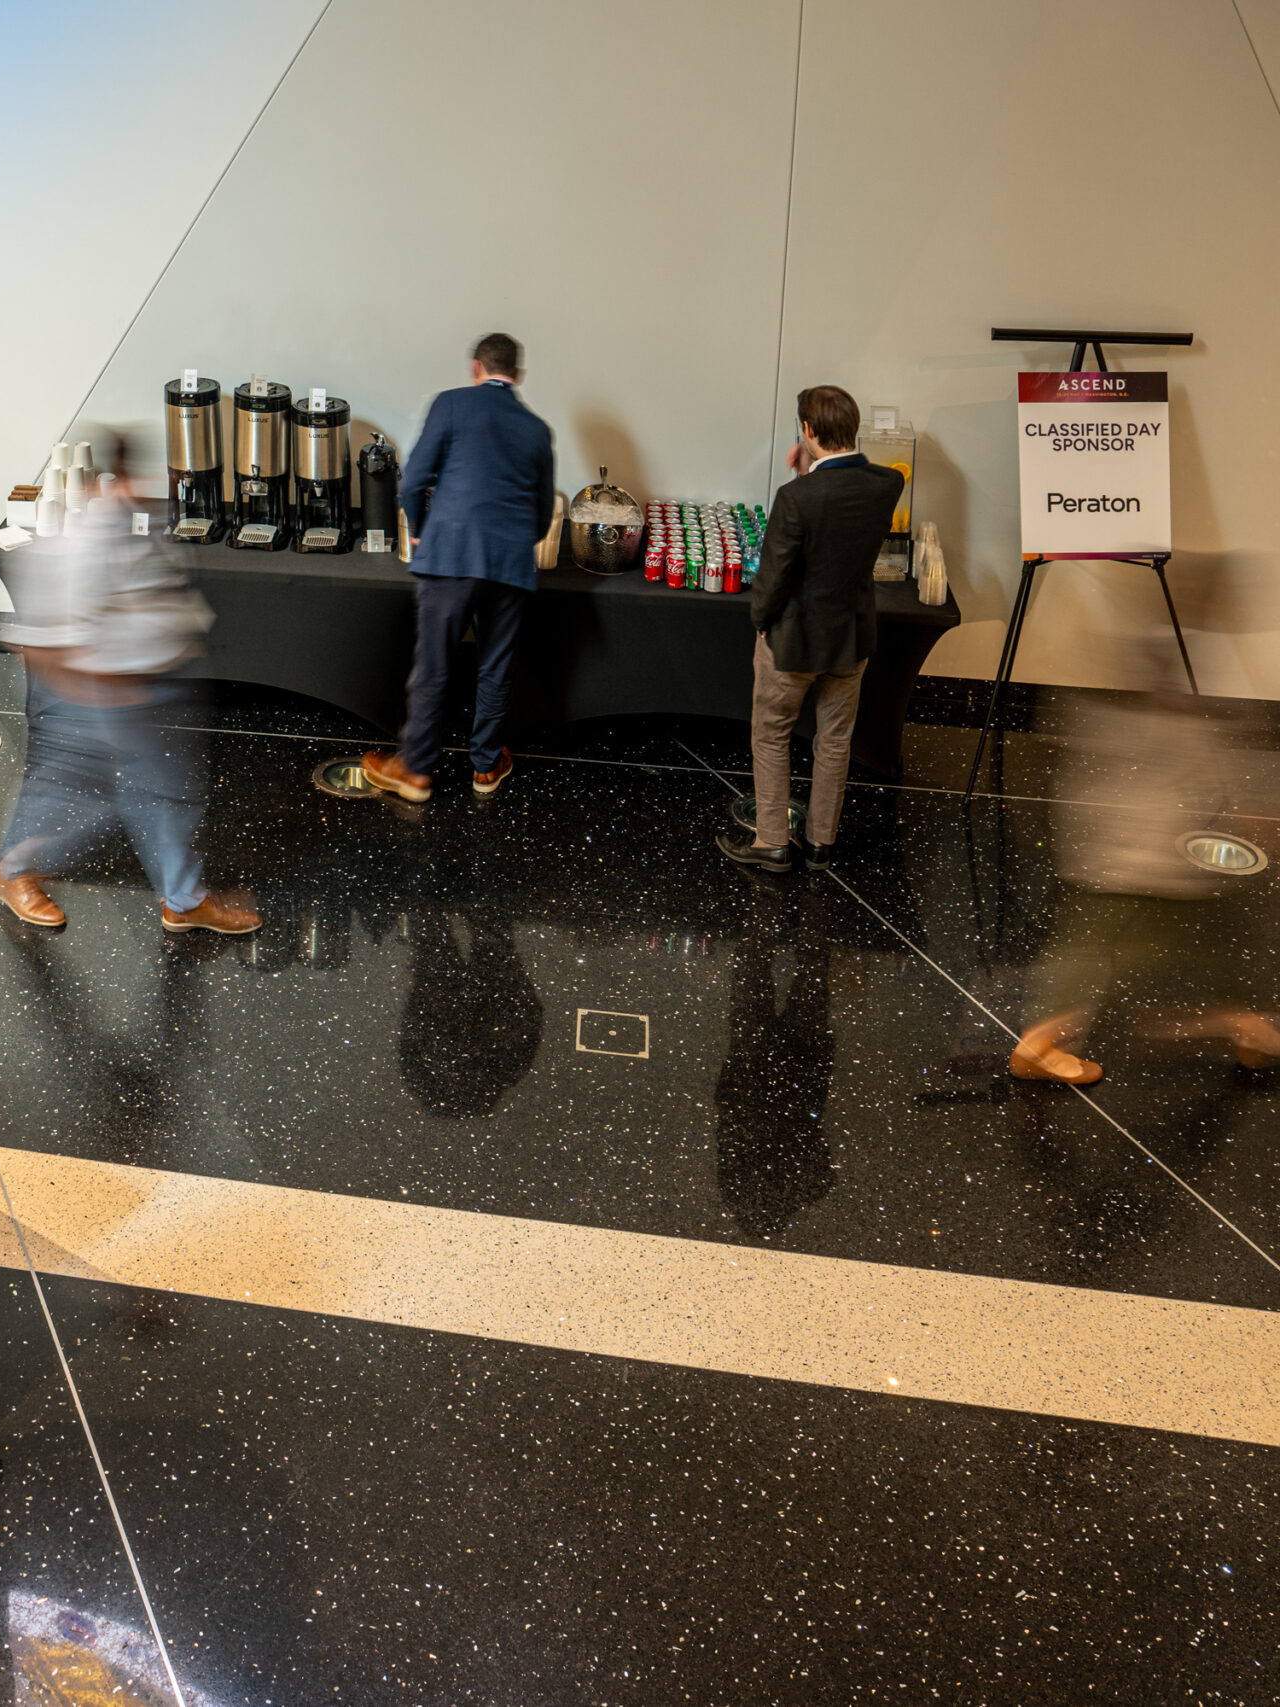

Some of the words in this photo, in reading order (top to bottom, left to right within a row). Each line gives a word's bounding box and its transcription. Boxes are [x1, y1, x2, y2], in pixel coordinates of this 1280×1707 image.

[1058, 378, 1126, 391] ASCEND
[1024, 422, 1122, 437] CLASSIFIED
[1126, 422, 1161, 437] DAY
[1052, 438, 1136, 452] SPONSOR
[1047, 492, 1141, 513] Peraton
